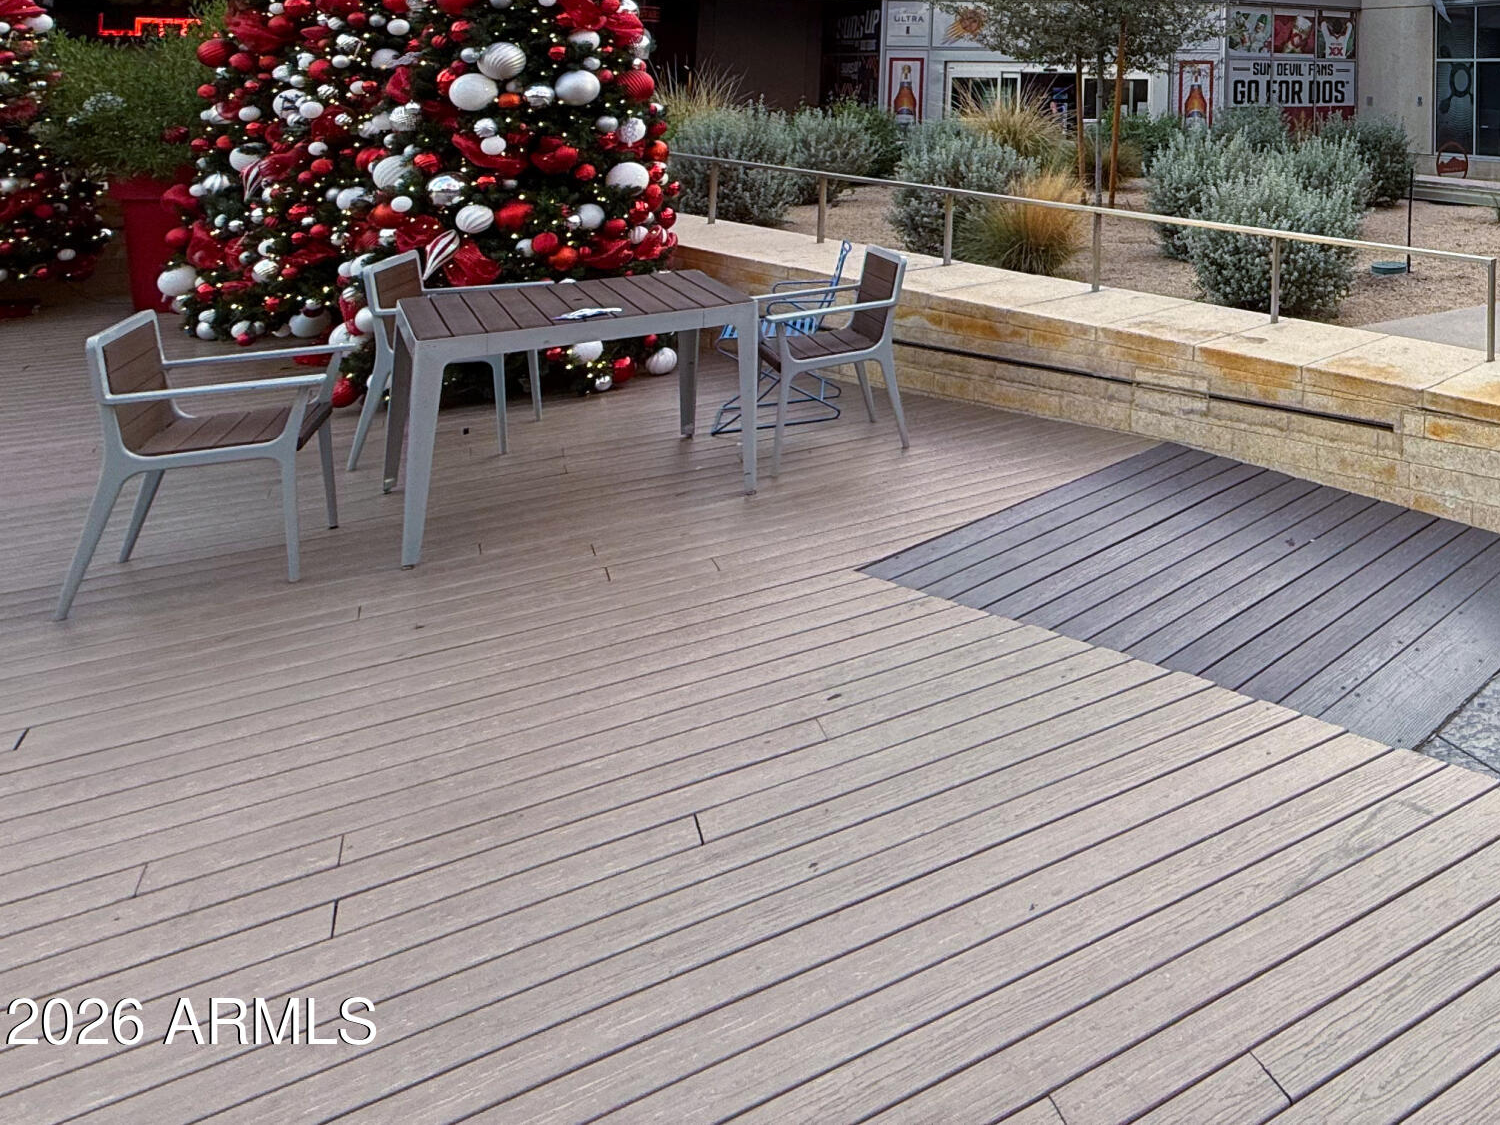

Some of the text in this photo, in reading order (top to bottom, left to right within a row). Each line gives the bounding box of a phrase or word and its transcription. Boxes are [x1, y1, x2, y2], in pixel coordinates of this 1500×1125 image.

[1252, 62, 1272, 76] SUN
[1308, 64, 1334, 76] FANS
[1233, 79, 1345, 105] GO FOR DOS
